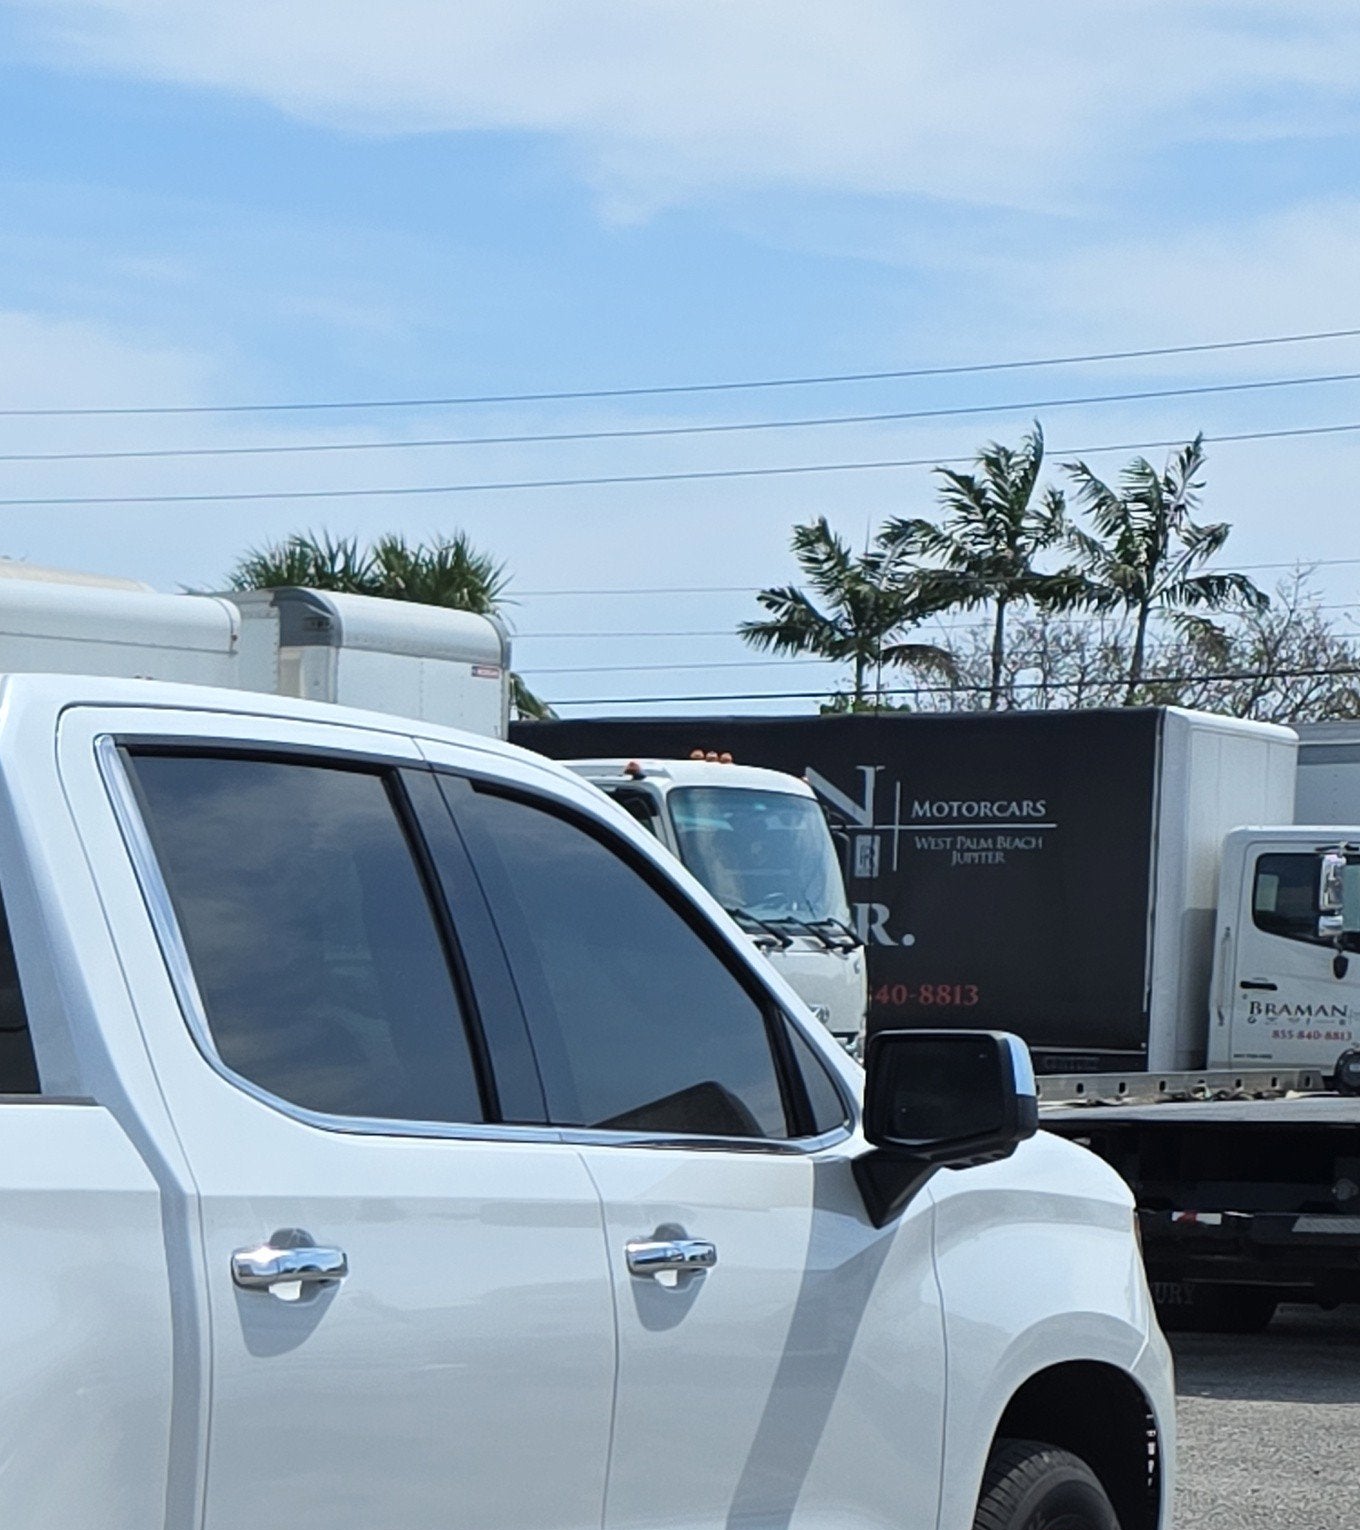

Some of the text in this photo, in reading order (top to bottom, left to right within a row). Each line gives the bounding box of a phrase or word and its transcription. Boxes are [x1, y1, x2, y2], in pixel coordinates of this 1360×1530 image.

[910, 799, 1047, 819] MOTORCARS
[914, 835, 1044, 851] WEST PALM BEACH
[1249, 1000, 1349, 1017] BRAMAN
